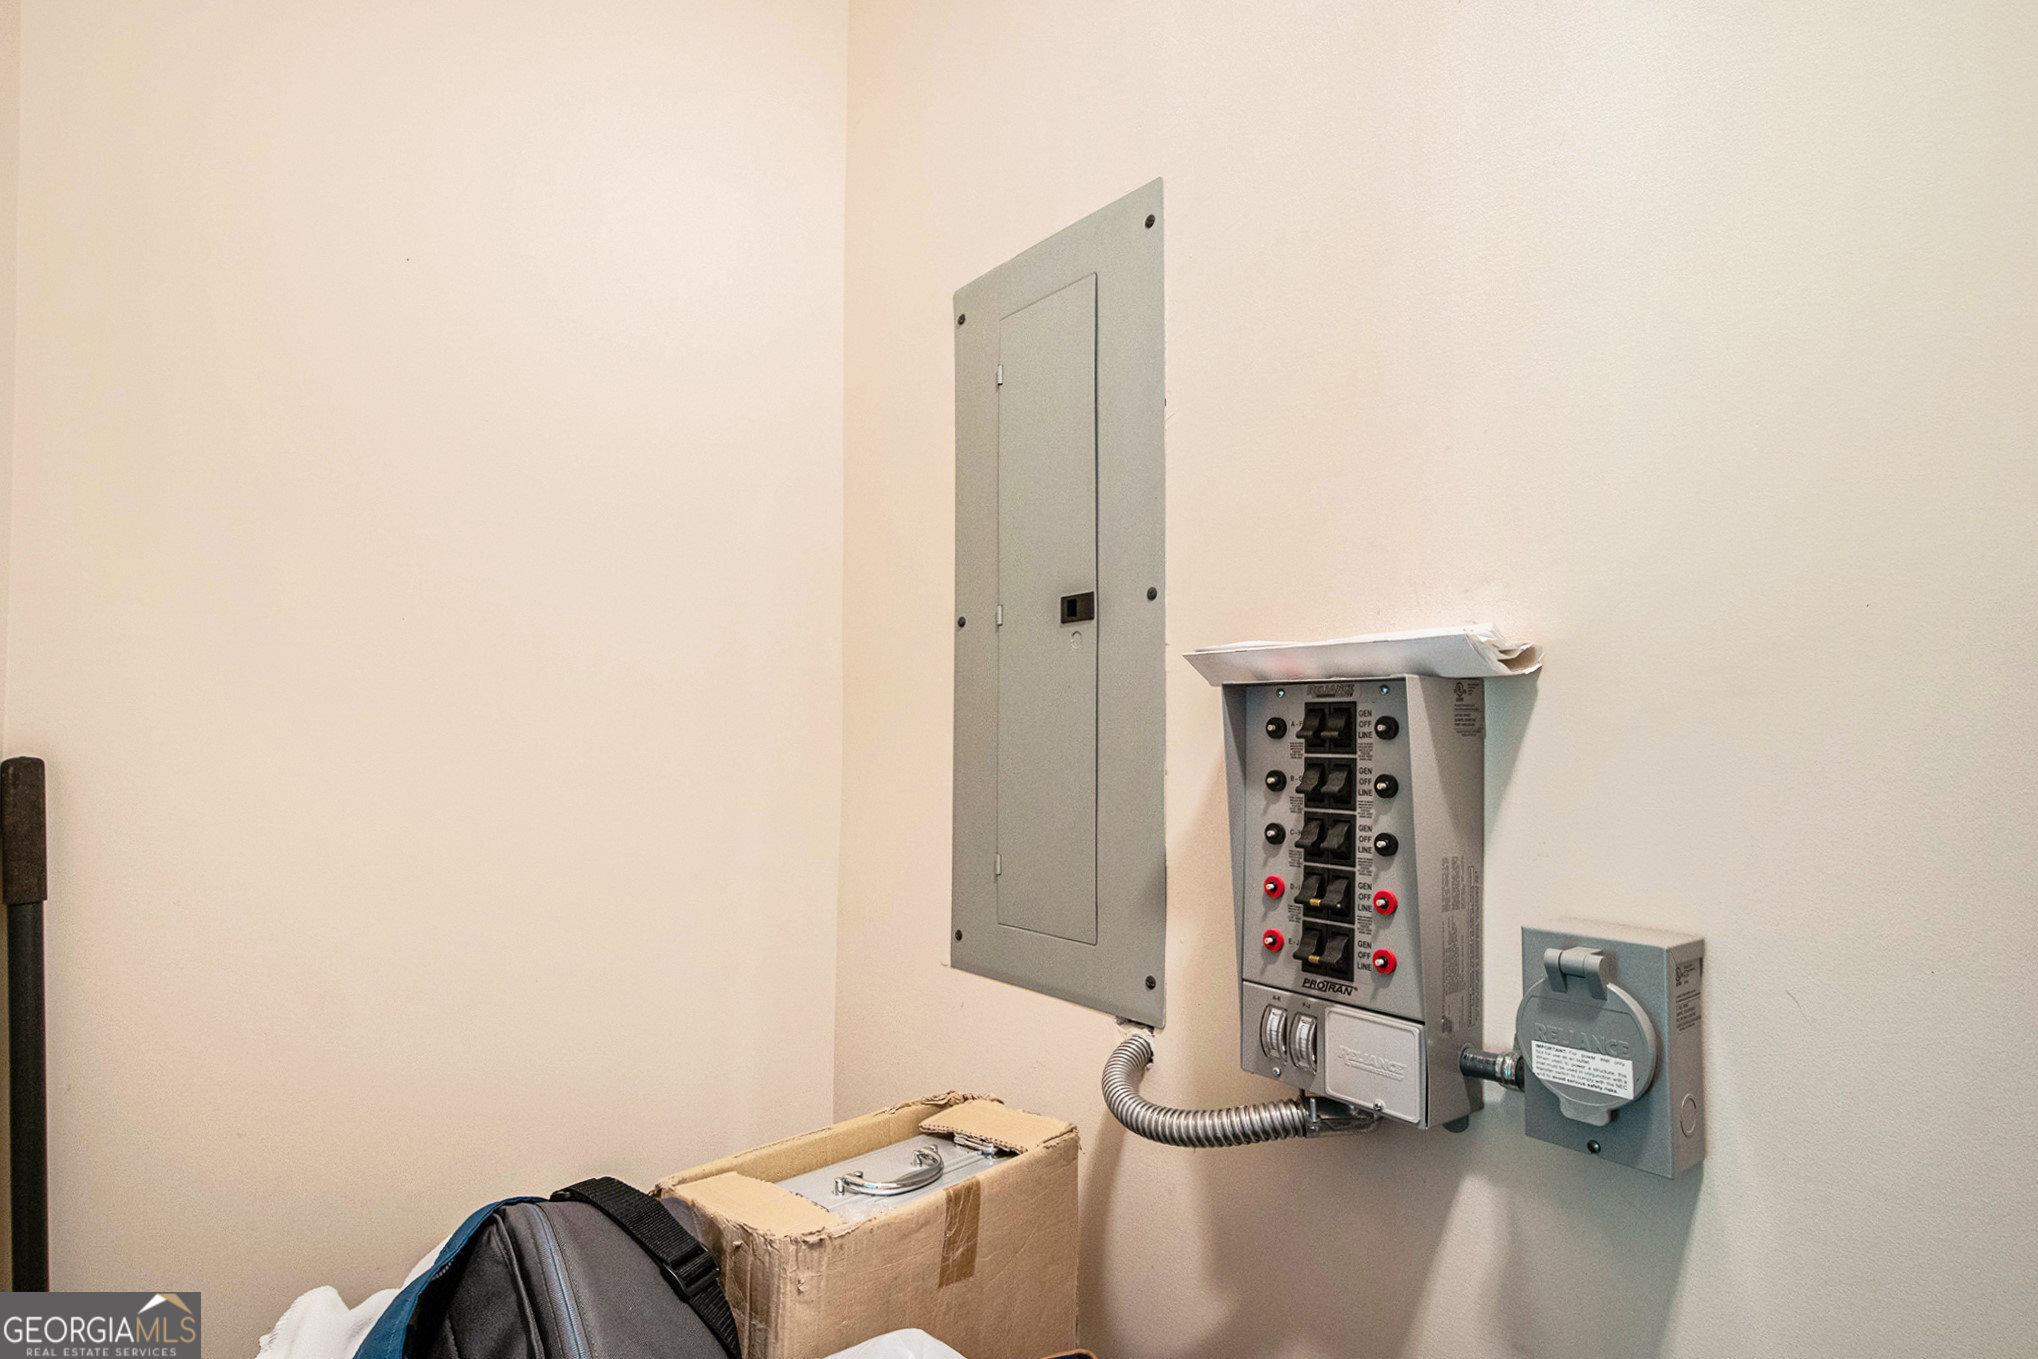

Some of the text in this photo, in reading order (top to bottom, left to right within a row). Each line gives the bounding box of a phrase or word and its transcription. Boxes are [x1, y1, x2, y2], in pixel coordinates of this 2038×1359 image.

[1358, 710, 1373, 718] GEN
[1358, 731, 1373, 739] LINE
[1358, 767, 1373, 775] GEN
[1358, 789, 1373, 797] LINE
[1358, 825, 1373, 833] GEN
[1358, 846, 1373, 854] LINE
[1357, 882, 1373, 890] GEN
[1358, 893, 1372, 901] OFF
[1357, 904, 1373, 913] LINE
[1357, 940, 1372, 949] GEN
[1357, 951, 1371, 960] OFF
[1357, 962, 1372, 972] LINE
[1534, 1022, 1631, 1060] RELIANCE
